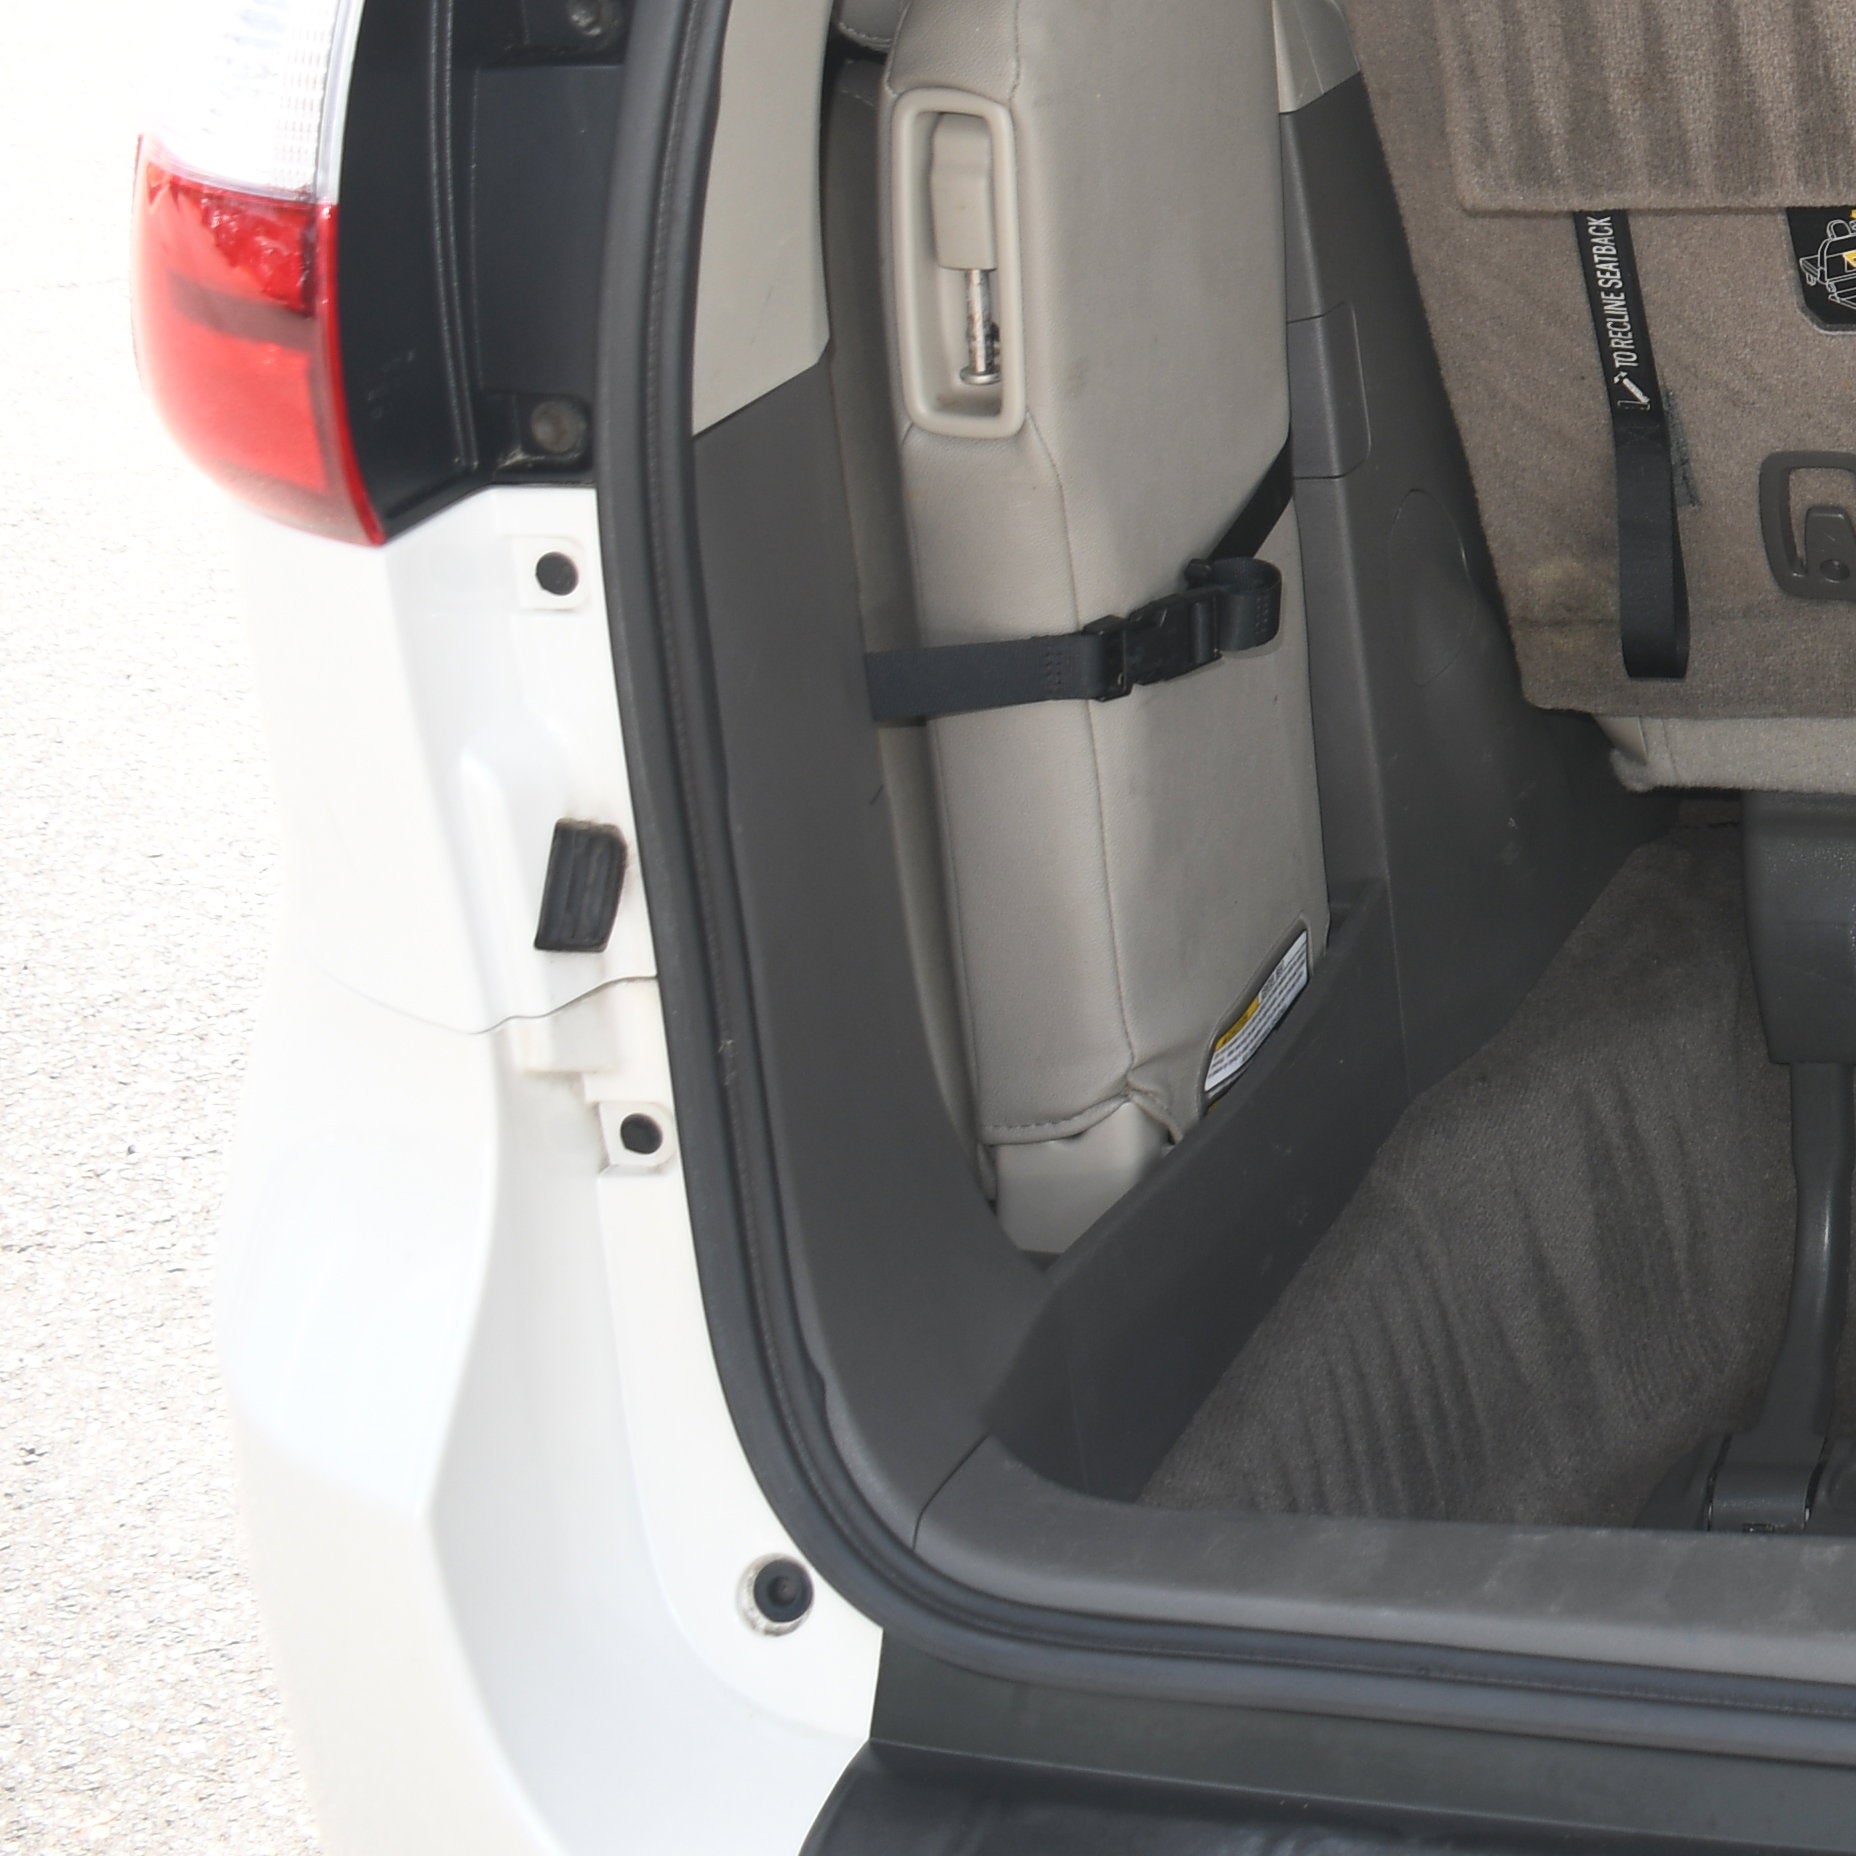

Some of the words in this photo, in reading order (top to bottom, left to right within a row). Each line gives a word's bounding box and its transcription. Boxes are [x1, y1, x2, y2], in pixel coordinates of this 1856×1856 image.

[1586, 216, 1624, 289] SEATBACK
[1600, 291, 1635, 349] RECLINE
[1613, 352, 1639, 368] TO
